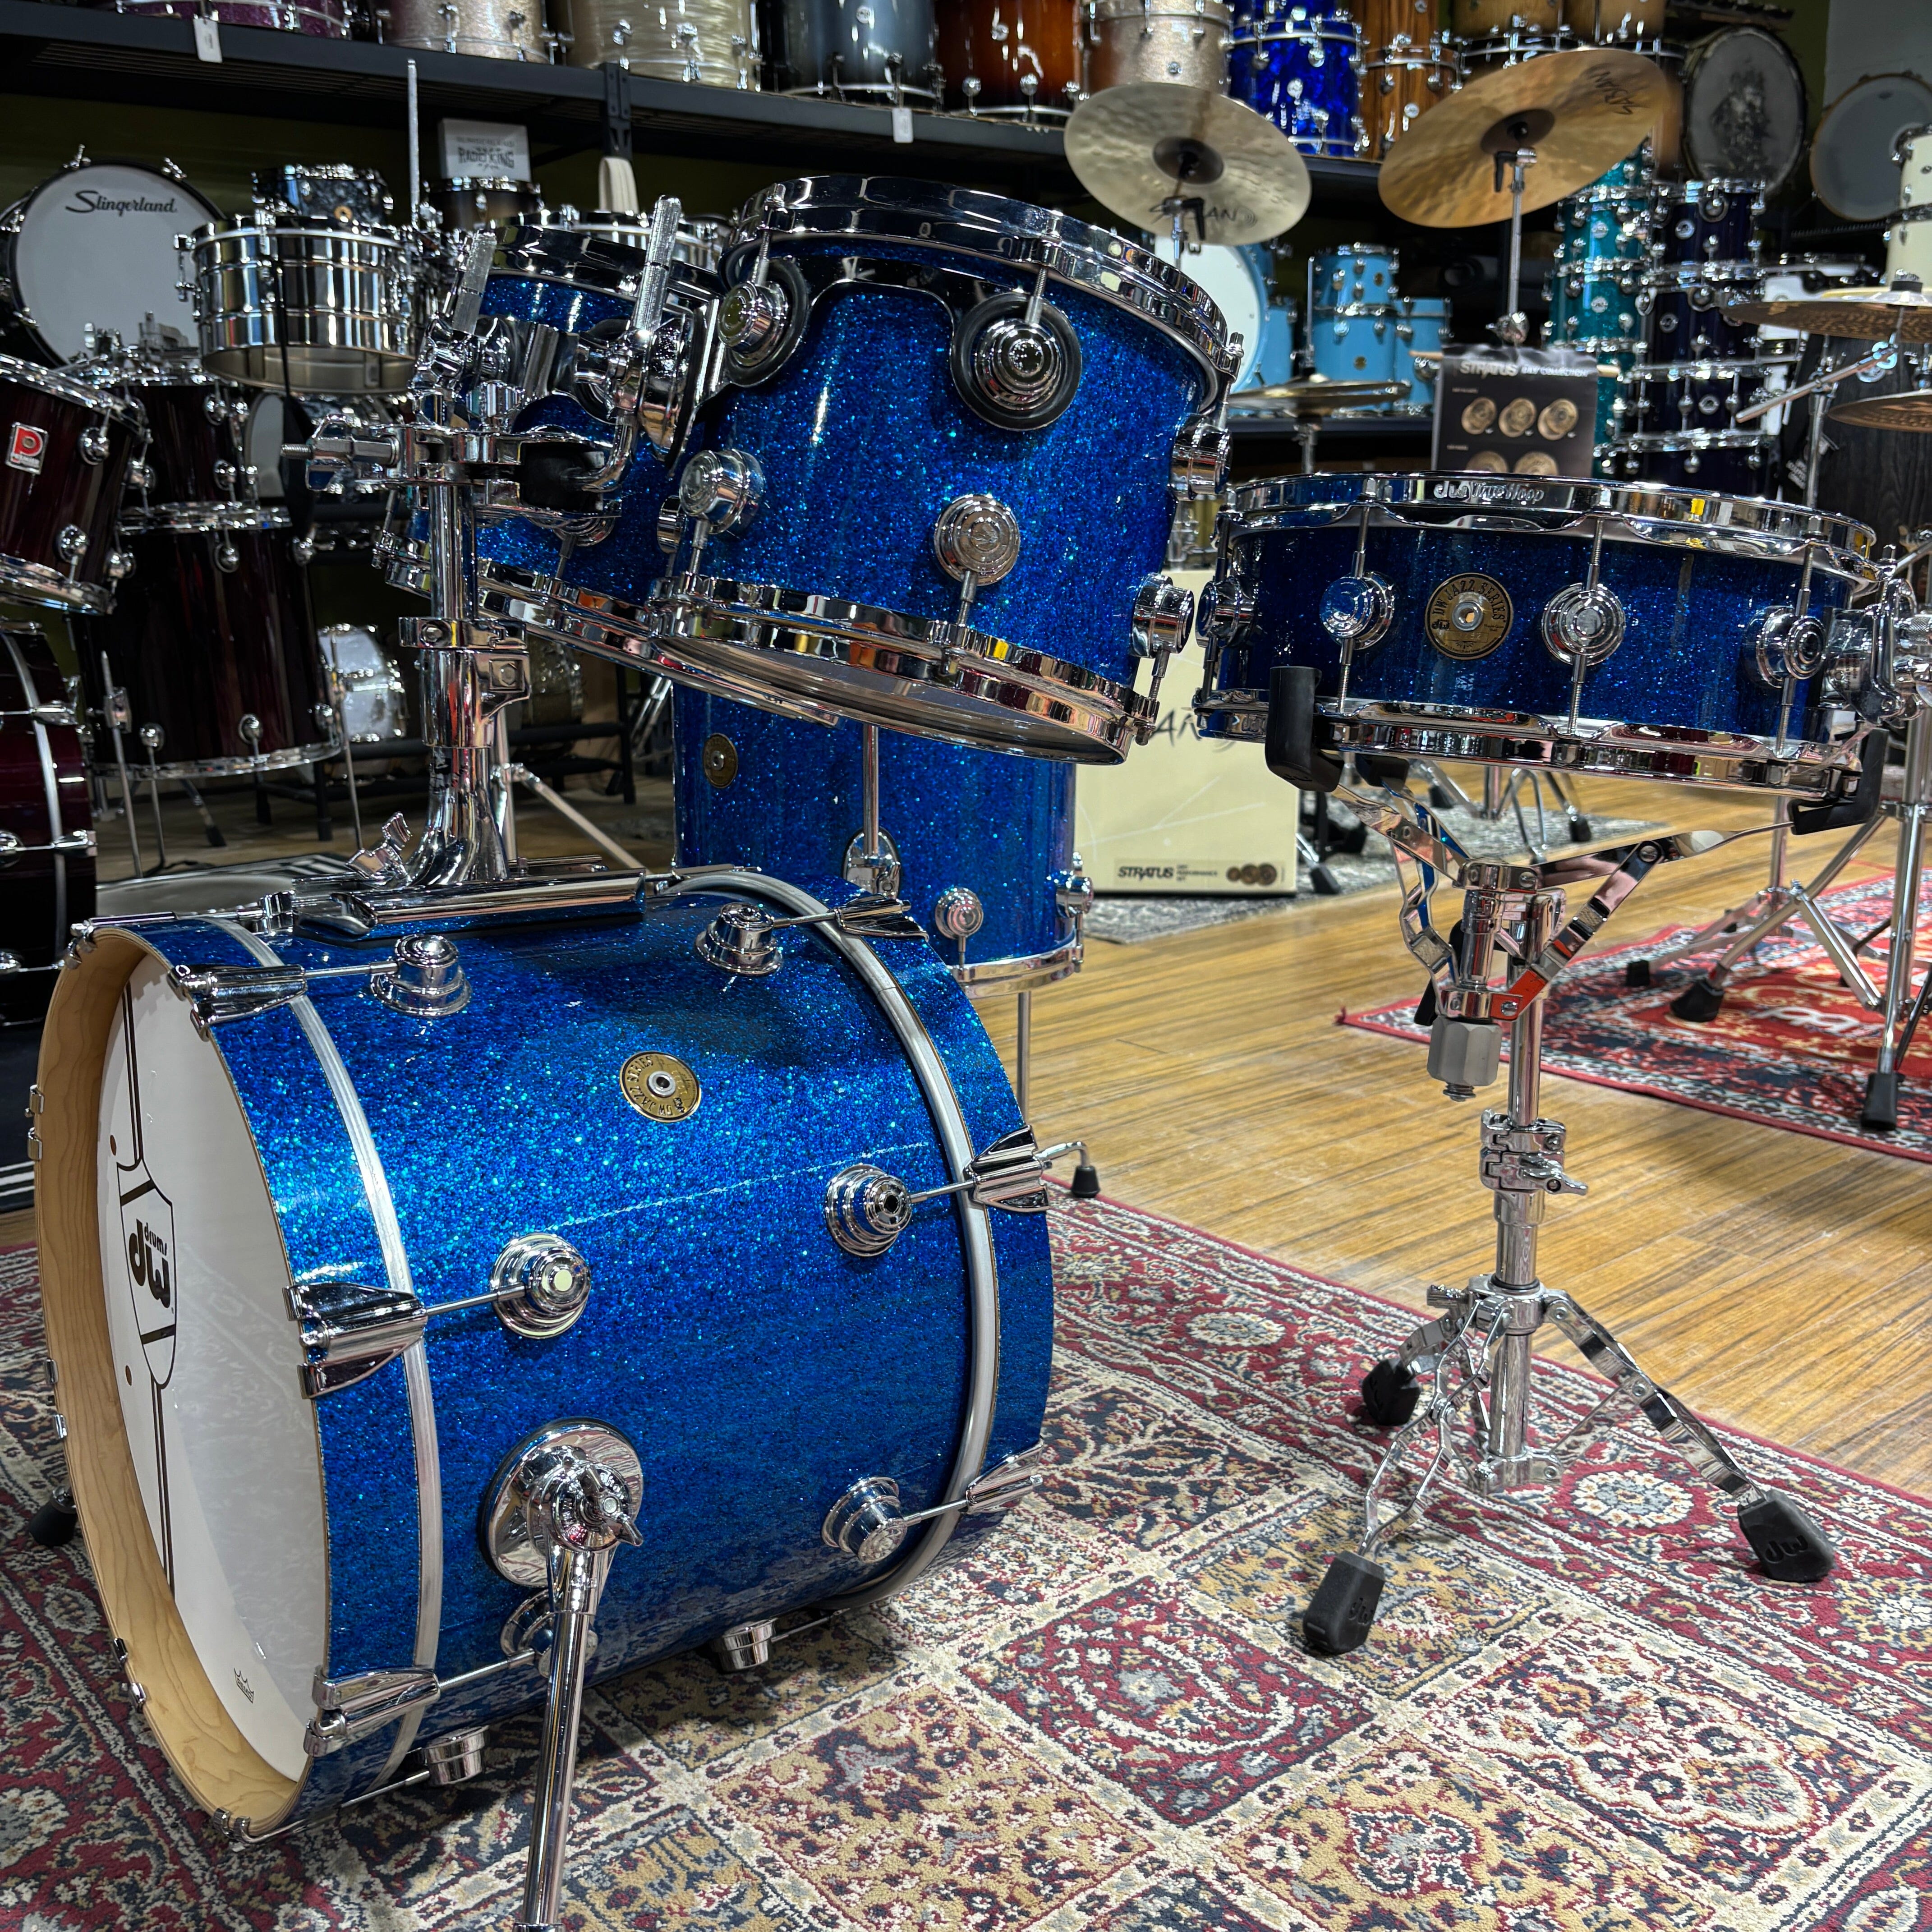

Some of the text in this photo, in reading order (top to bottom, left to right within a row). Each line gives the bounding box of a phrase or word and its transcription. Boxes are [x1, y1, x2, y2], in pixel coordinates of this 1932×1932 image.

[65, 190, 177, 217] Slingerland
[1444, 580, 1474, 601] JAZZ
[1118, 866, 1174, 881] STRATUS
[626, 1055, 654, 1083] SERIES
[630, 1085, 657, 1111] JAZZ
[144, 1222, 167, 1256] drums
[129, 1219, 171, 1308] dw
